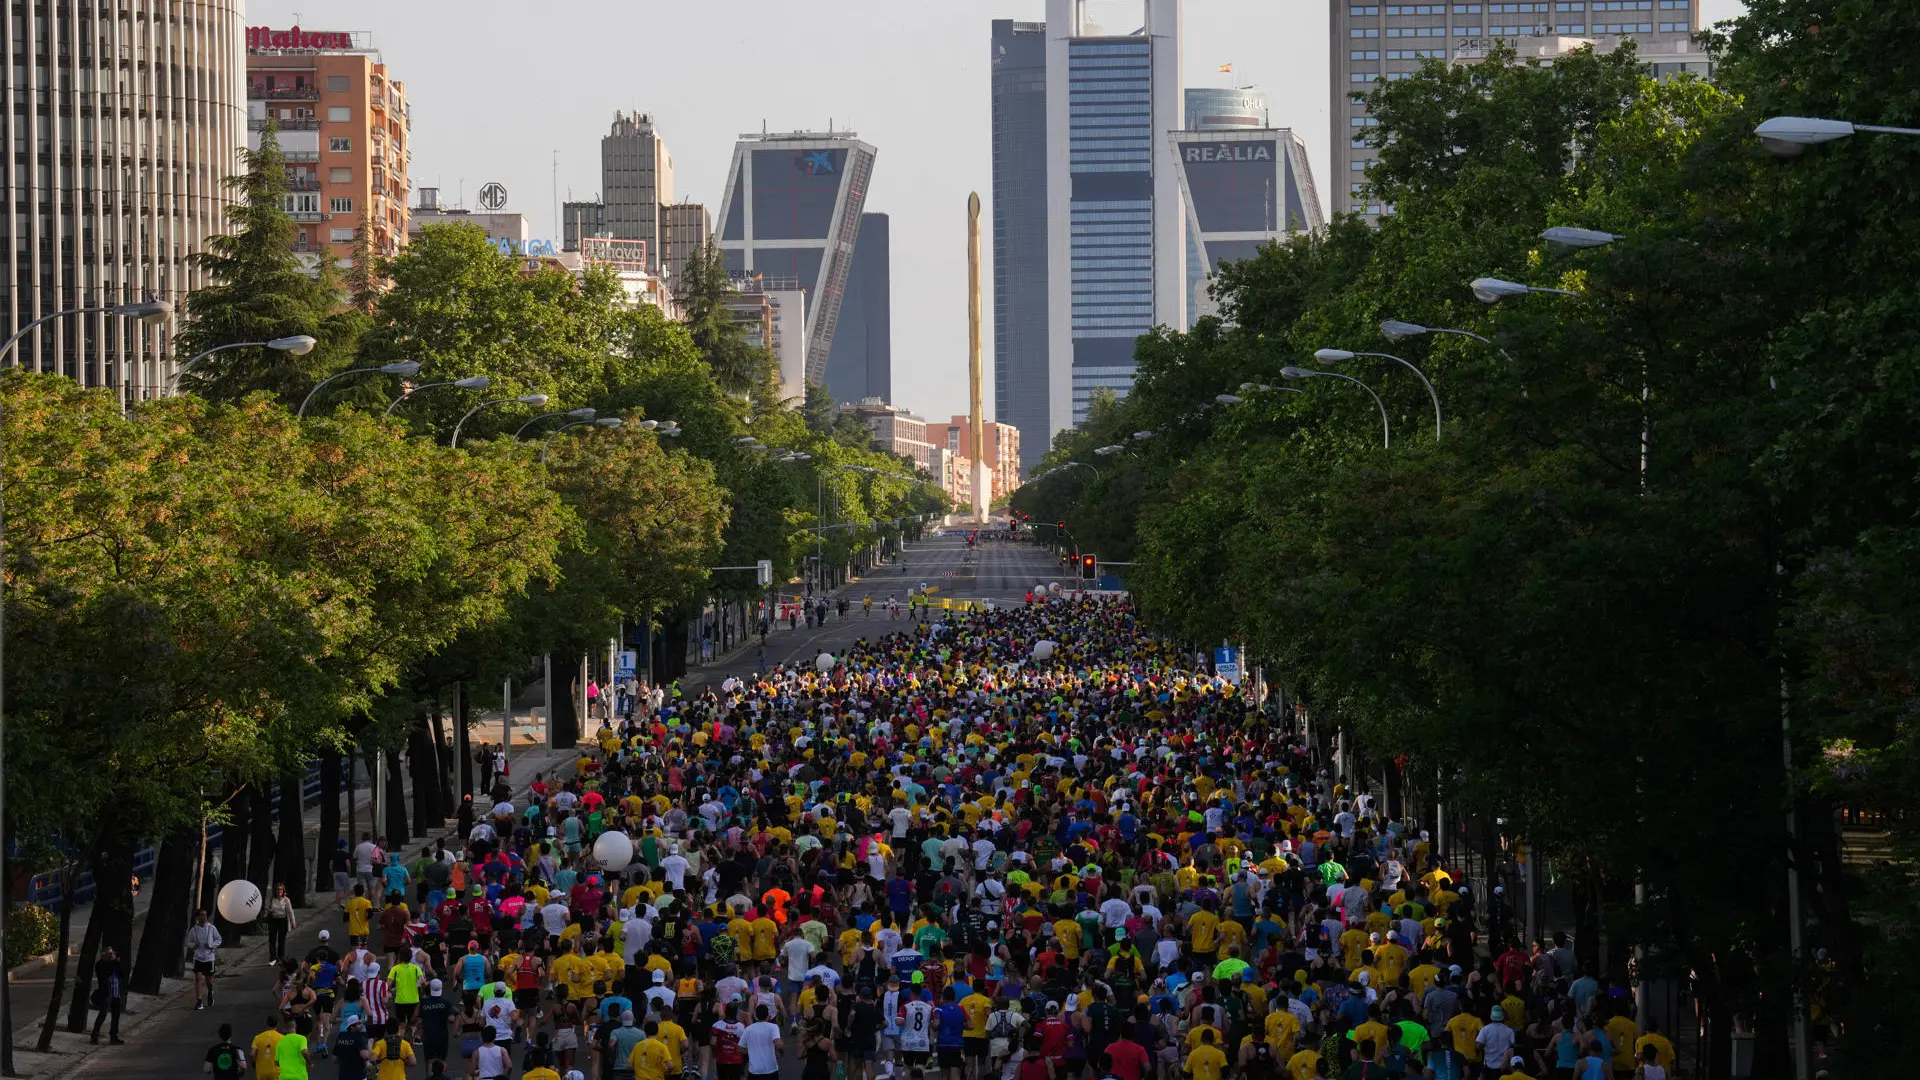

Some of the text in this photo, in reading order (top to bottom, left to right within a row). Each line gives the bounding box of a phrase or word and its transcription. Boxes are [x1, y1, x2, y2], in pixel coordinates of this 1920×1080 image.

[245, 25, 348, 50] Mahou
[483, 185, 504, 208] MG
[620, 655, 628, 667] 1
[1222, 649, 1230, 663] 1
[914, 1011, 923, 1031] 8
